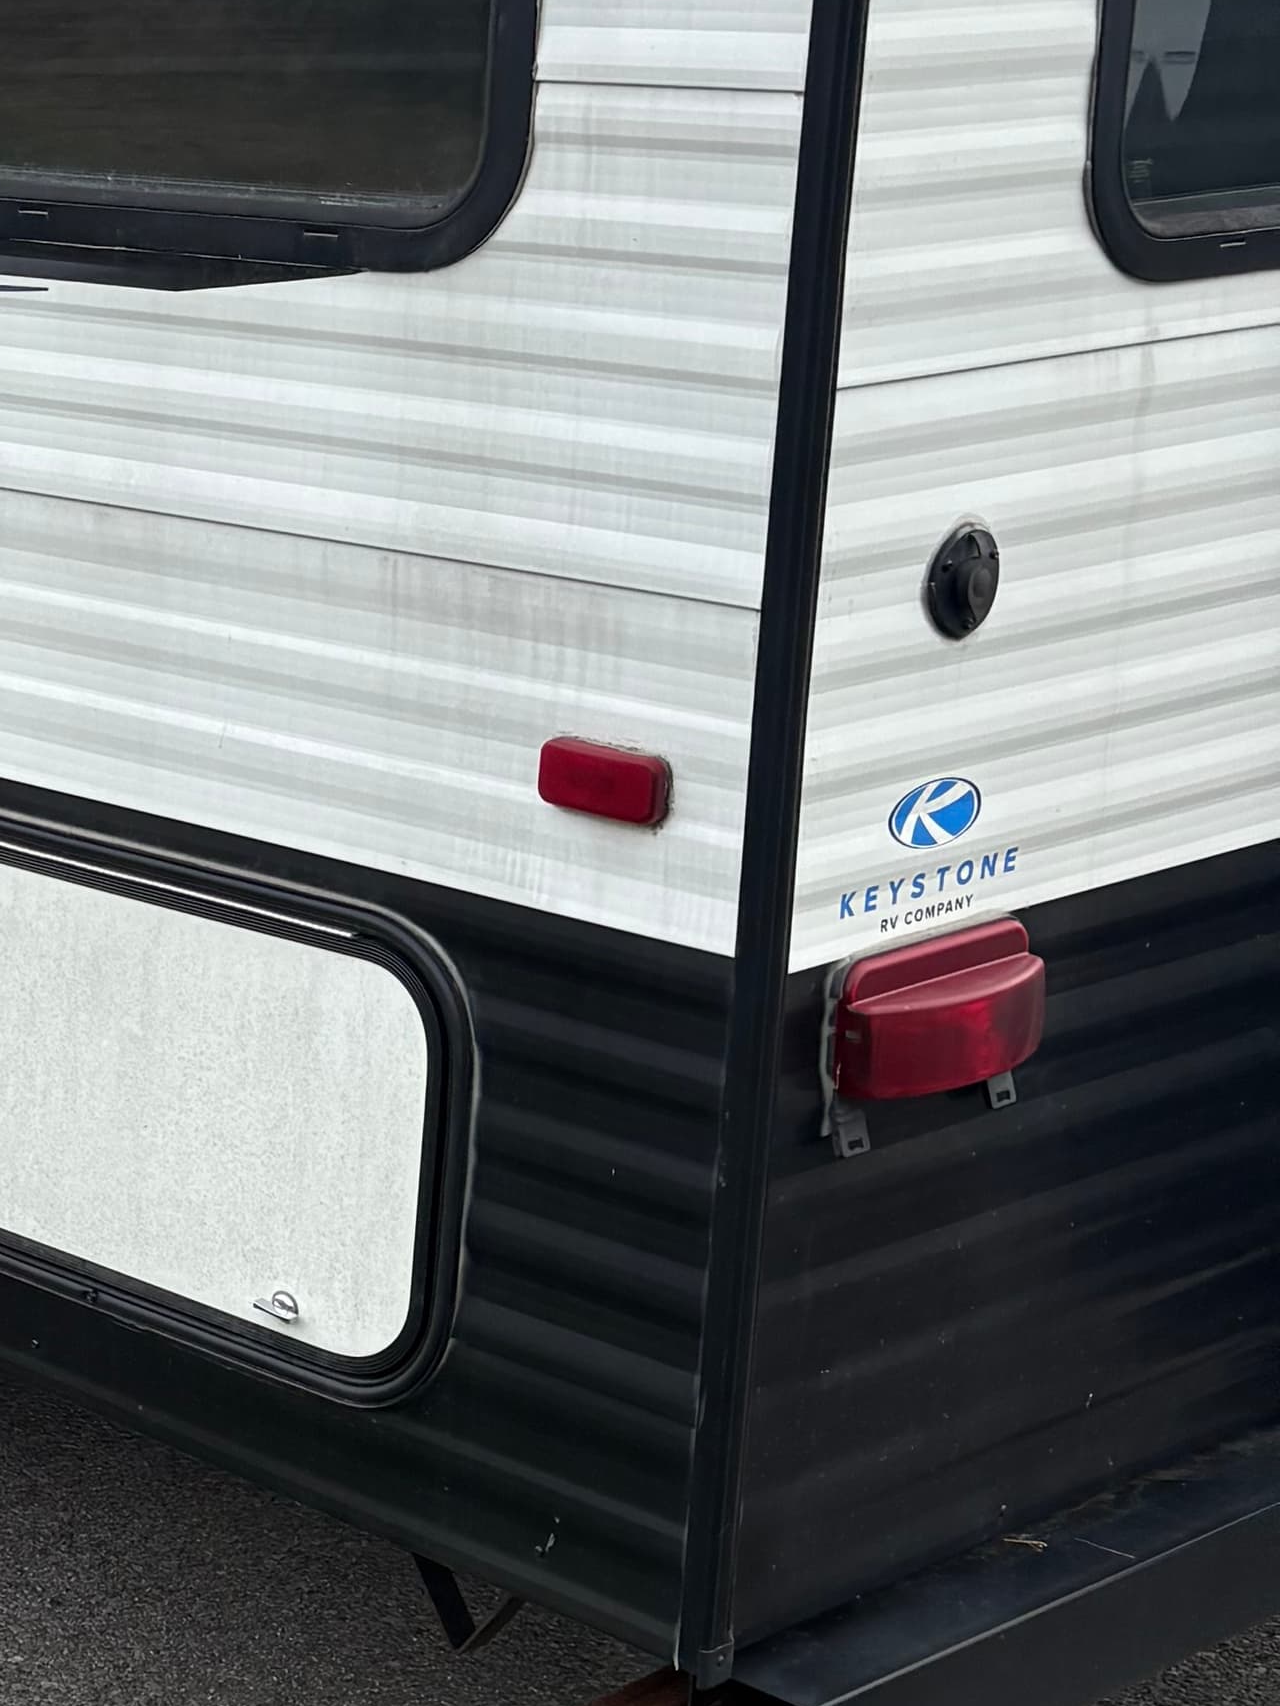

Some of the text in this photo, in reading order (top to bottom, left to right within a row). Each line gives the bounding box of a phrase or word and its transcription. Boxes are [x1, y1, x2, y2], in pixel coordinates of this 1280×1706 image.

[840, 847, 1019, 919] KEYSTONE
[880, 895, 973, 933] RV COMPANY
